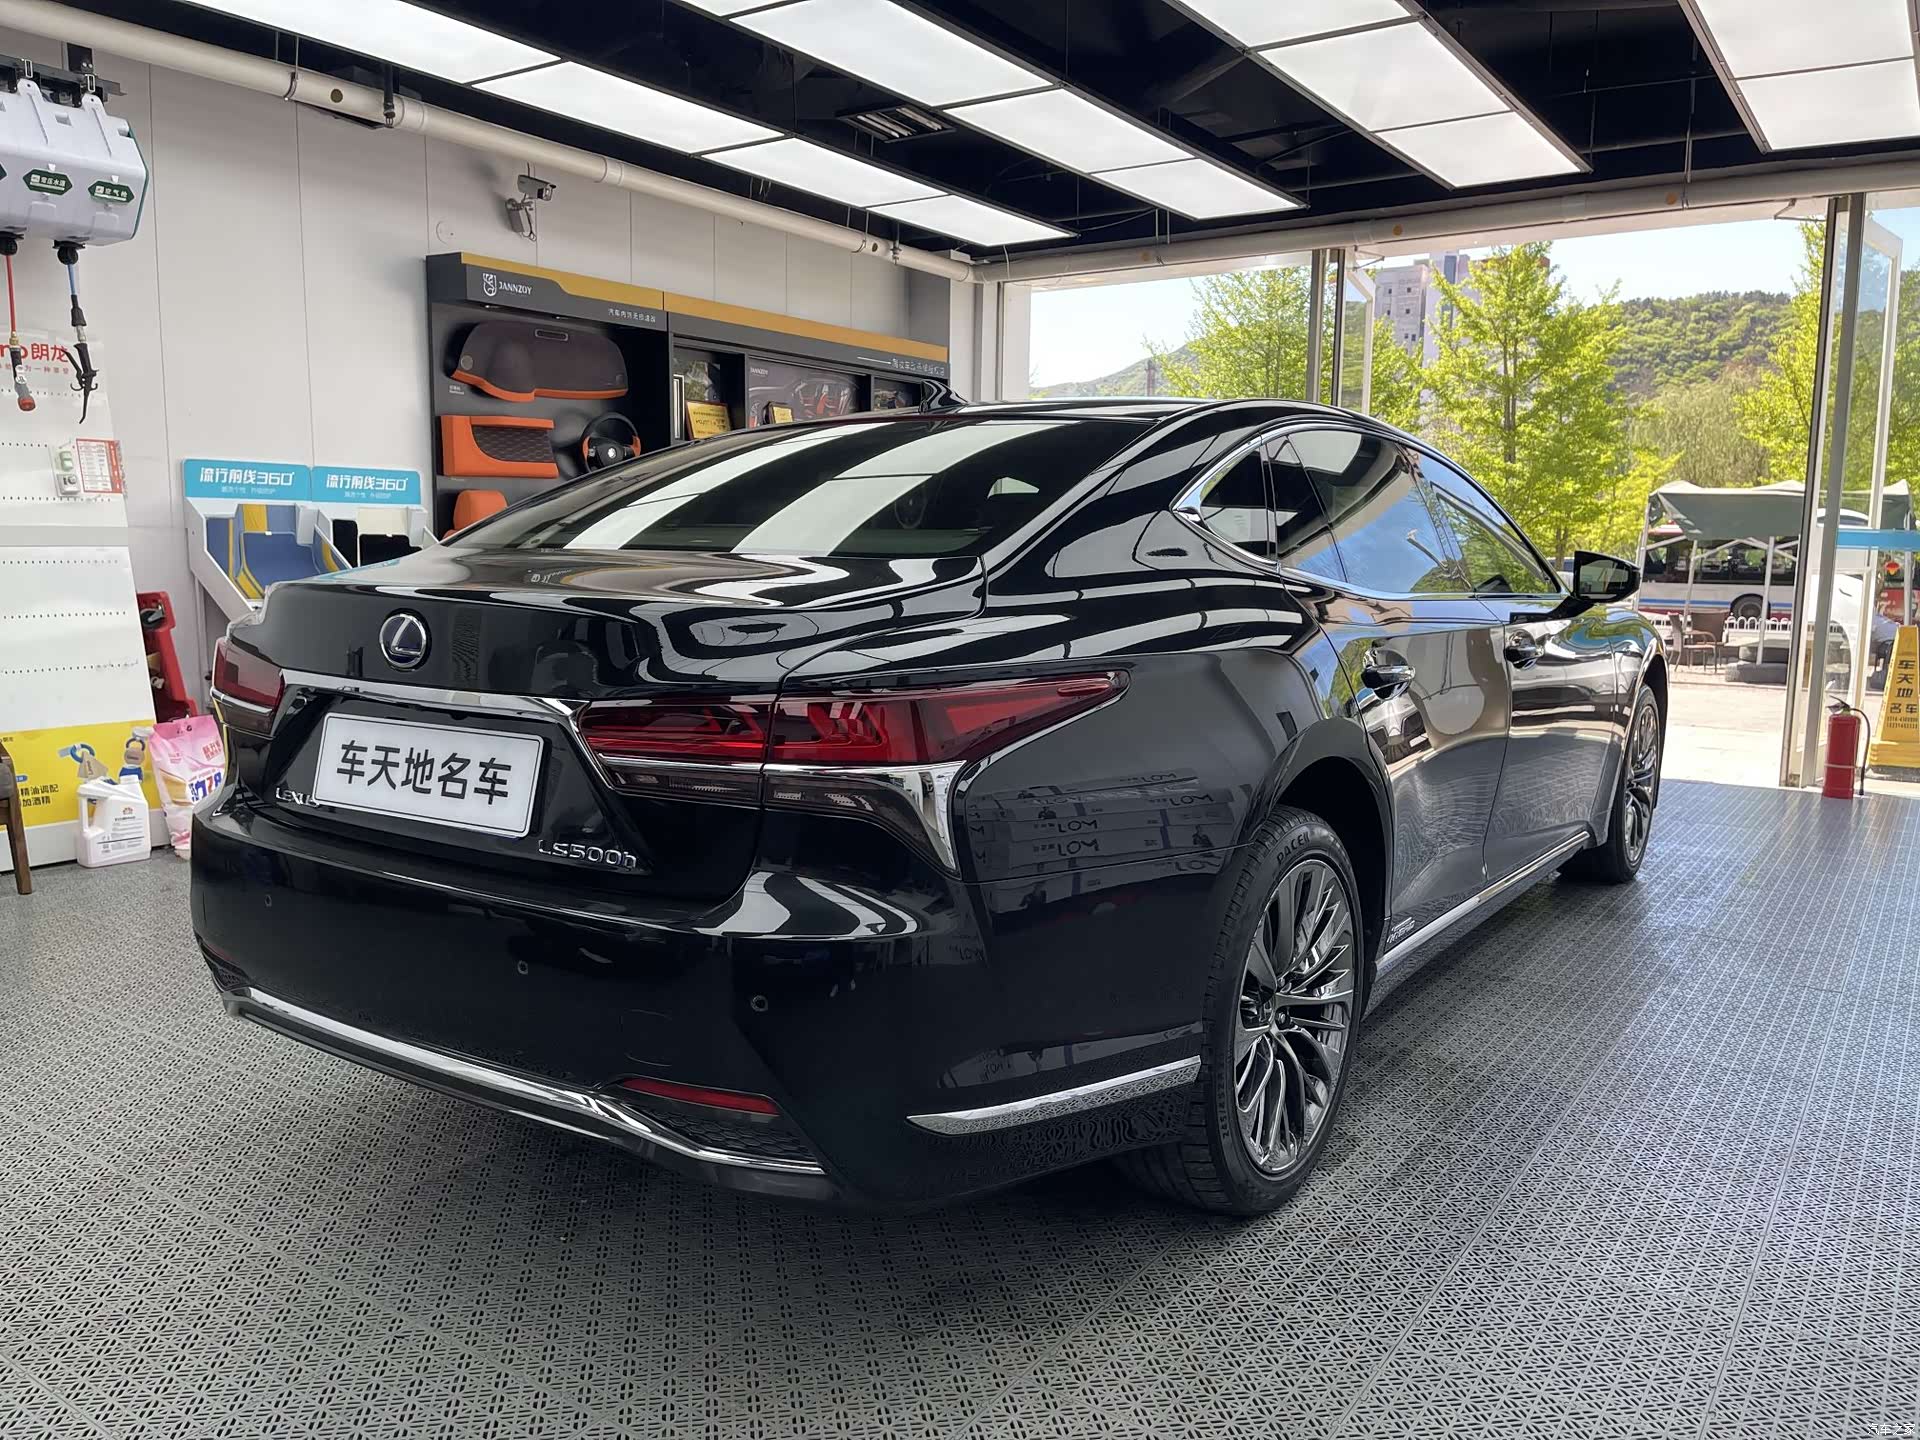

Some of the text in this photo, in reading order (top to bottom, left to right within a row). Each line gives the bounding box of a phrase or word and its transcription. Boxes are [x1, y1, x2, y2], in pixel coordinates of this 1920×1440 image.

[336, 740, 512, 806] 车天地名车
[538, 840, 637, 869] LS500h
